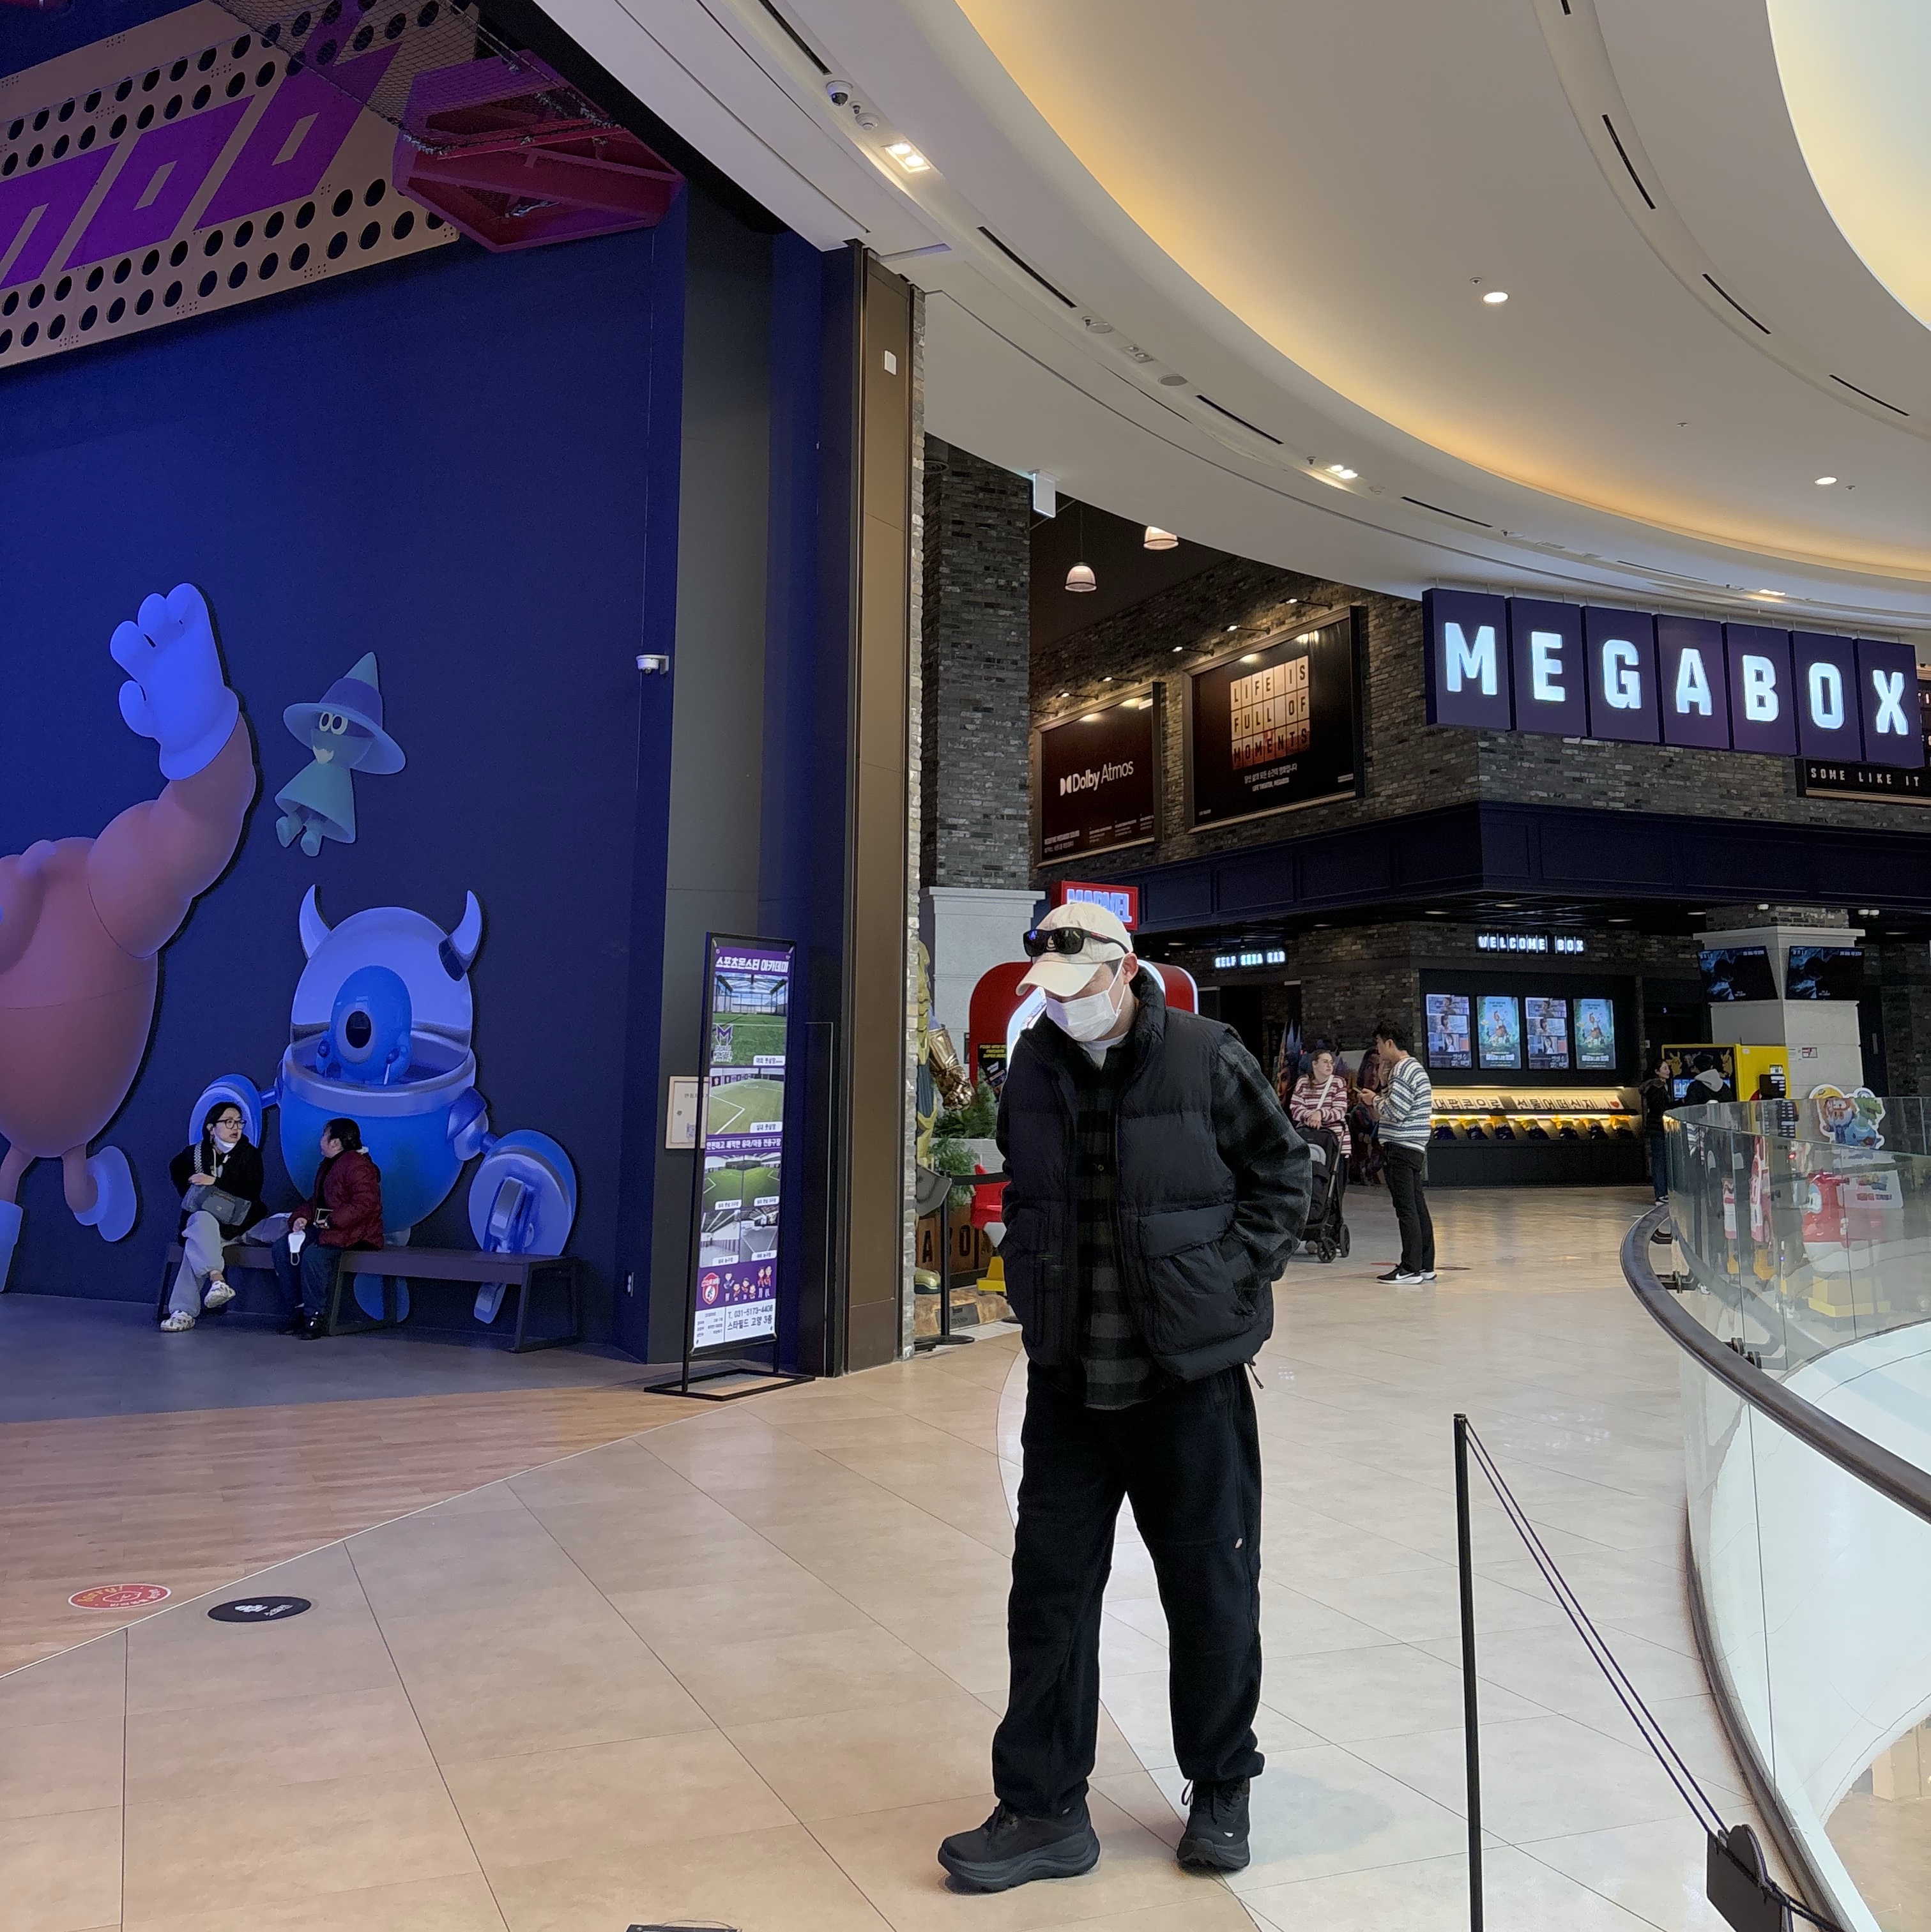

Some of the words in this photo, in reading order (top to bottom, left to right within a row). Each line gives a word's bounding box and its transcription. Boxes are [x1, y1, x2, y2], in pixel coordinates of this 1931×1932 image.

[1233, 676, 1271, 703] LIFE
[1289, 664, 1306, 685] IS
[1445, 622, 1909, 736] MEGABOX
[1234, 707, 1272, 733] FULL
[1288, 696, 1306, 716] OF
[1233, 727, 1307, 763] MOMENTS
[1072, 768, 1101, 791] Dolby
[1101, 761, 1134, 784] Atmos
[1810, 767, 1845, 781] SOME
[1858, 771, 1892, 785] LIKE
[1905, 775, 1920, 787] IT
[1478, 936, 1546, 951] WELCOME
[1557, 939, 1584, 952] BOX
[715, 957, 760, 971] 스포츠몬스터
[760, 959, 790, 973] 아카데미
[1215, 955, 1237, 968] SELF
[727, 1319, 750, 1330] 스타필드
[751, 1316, 762, 1327] 고양
[763, 1314, 772, 1325] 3층
